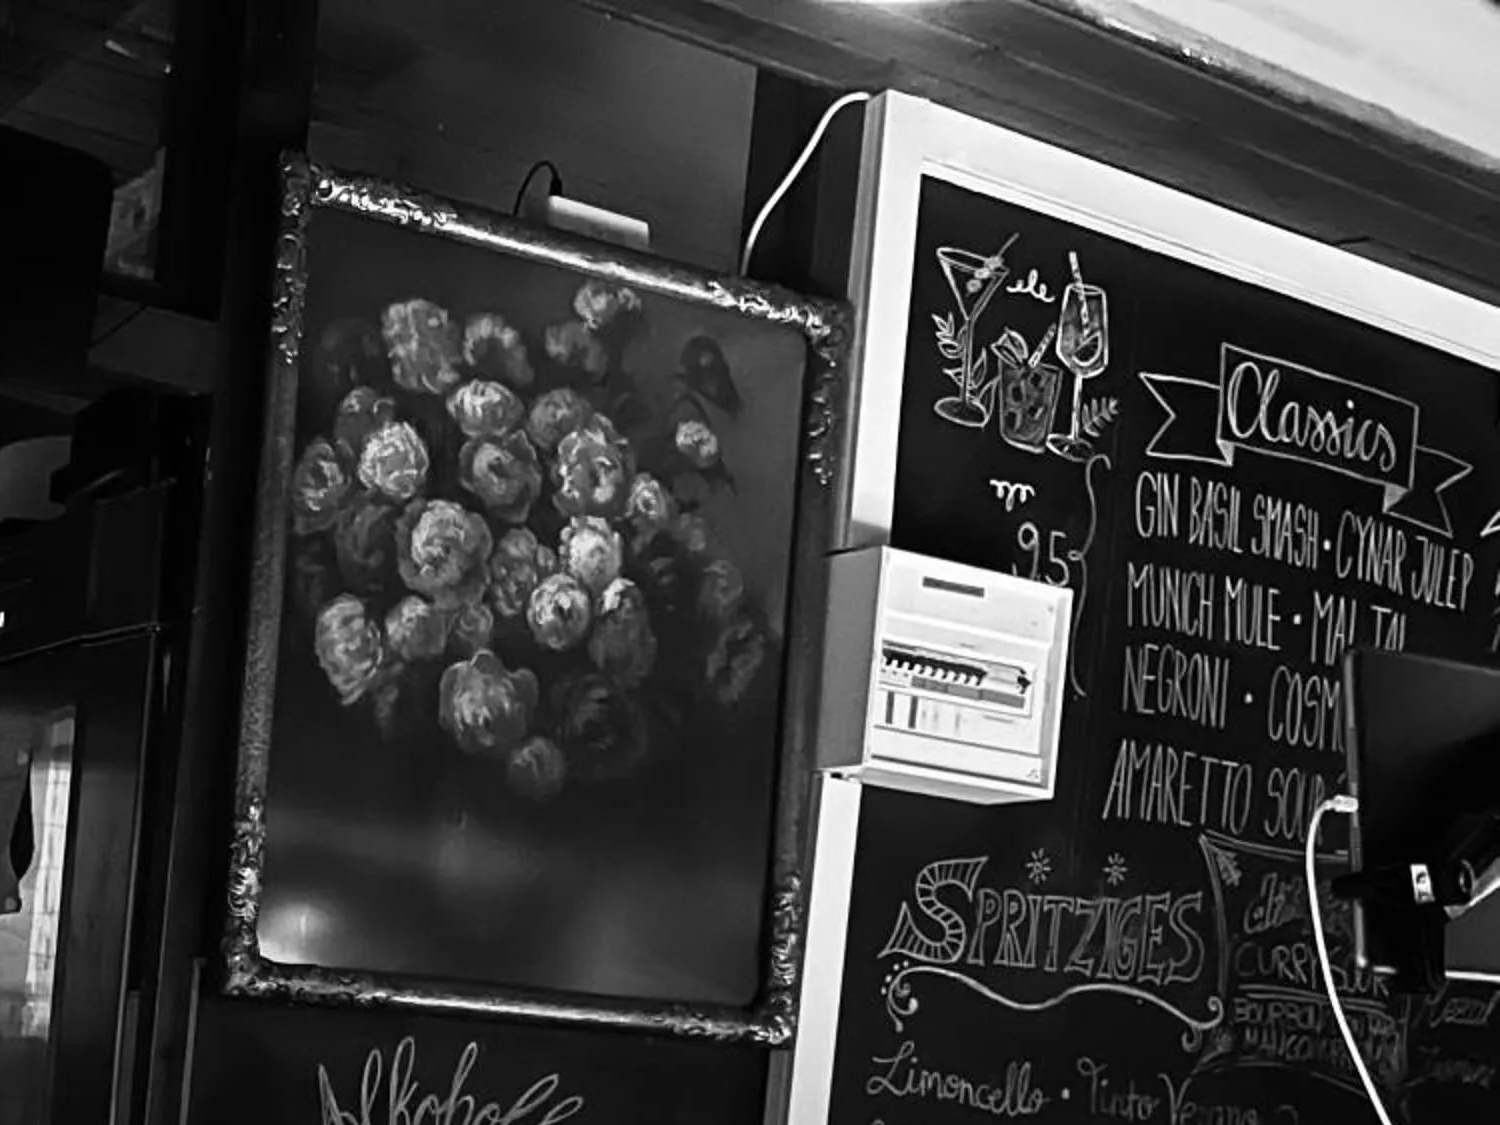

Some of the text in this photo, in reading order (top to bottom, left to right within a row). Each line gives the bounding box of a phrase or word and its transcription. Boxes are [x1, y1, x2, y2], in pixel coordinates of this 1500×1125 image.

[1228, 361, 1398, 473] Classics
[1134, 471, 1475, 613] GIN BASIL SMASH CYNAR JULEP
[1126, 561, 1408, 666] MUNICH MULE MAI TAI
[1122, 642, 1346, 753] NEGRONI COSM
[1102, 738, 1254, 836] AMARETTO
[877, 855, 1206, 986] SPRITZIGES
[866, 1039, 1046, 1117] Limoncello
[1076, 1057, 1158, 1121] Tinto
